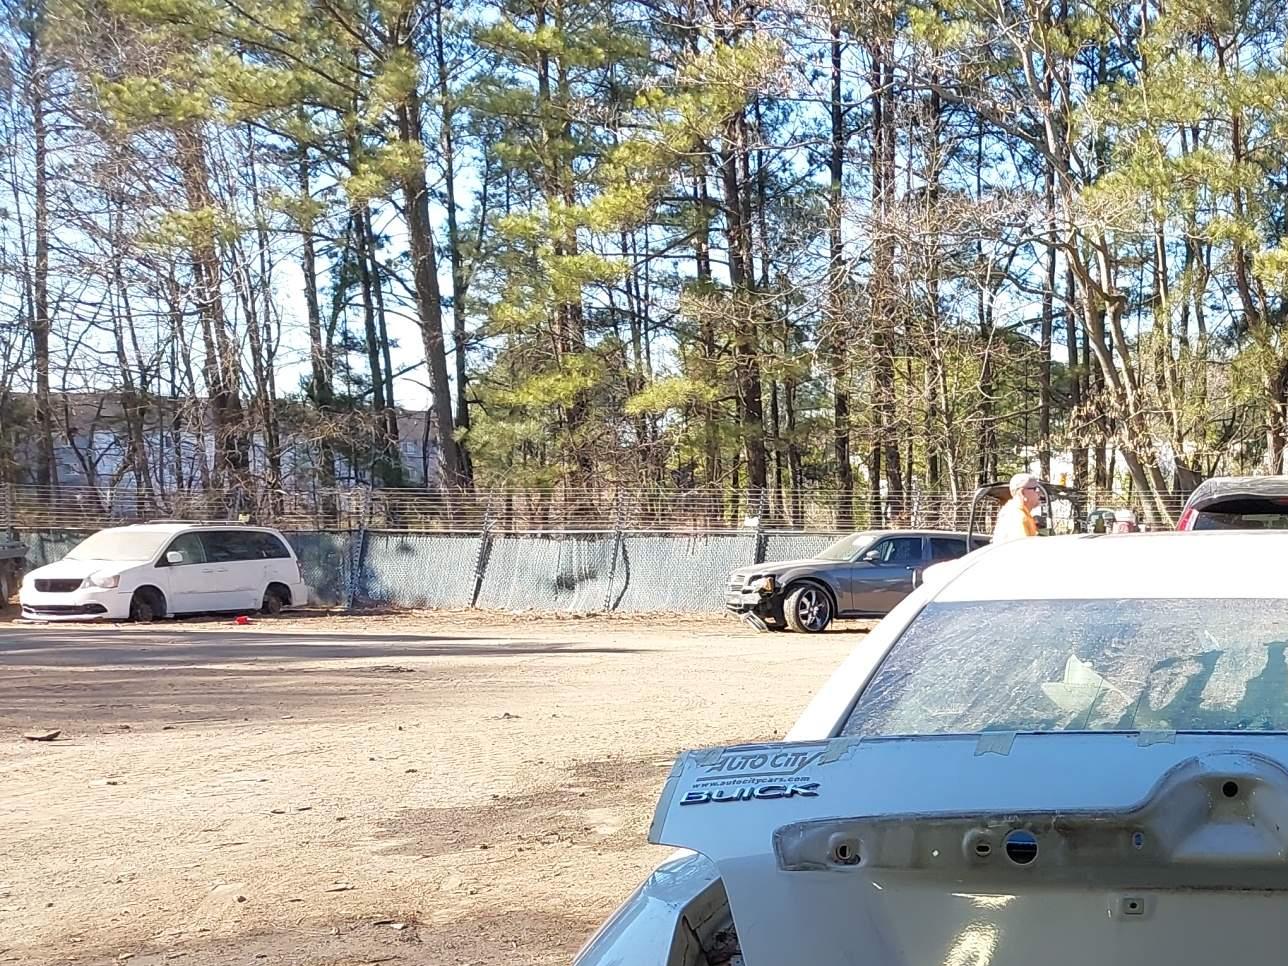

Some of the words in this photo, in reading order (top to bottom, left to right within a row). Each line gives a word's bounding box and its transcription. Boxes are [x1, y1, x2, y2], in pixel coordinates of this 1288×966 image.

[704, 753, 769, 773] AUTO
[692, 776, 811, 789] www.autocitycars.com
[680, 782, 821, 805] BUICK
